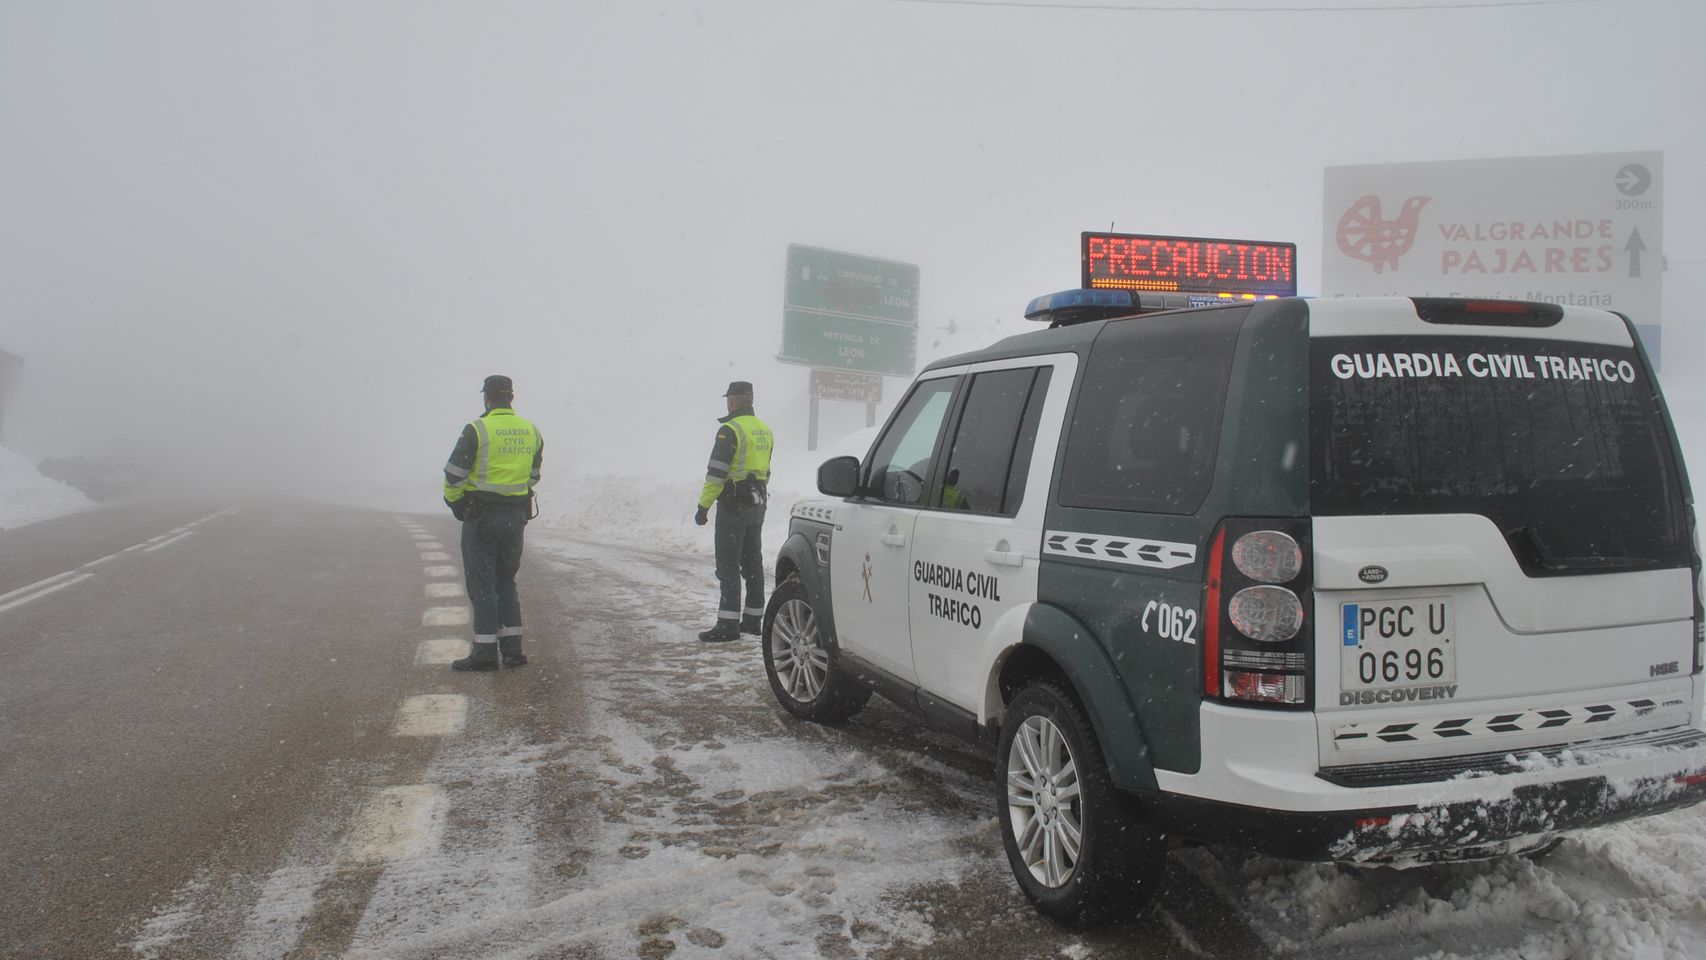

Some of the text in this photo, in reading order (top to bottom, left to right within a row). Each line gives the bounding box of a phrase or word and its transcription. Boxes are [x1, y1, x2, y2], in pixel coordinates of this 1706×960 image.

[1438, 219, 1613, 242] VALGRANDE
[1089, 237, 1291, 282] PRECAUCION
[1441, 244, 1613, 275] PAJARES
[1526, 290, 1613, 306] Montaña
[823, 330, 864, 344] PROVINCIA
[1331, 352, 1636, 384] GUARDIA CIVIL TRAFICO
[496, 428, 531, 437] GUARDIA
[503, 437, 525, 446] CIVIL
[913, 559, 1001, 602] GUARDIA CIVIL
[928, 593, 981, 630] TRAFICO
[1157, 603, 1197, 645] 062
[1360, 603, 1445, 640] PGC U
[1347, 629, 1355, 640] E
[1359, 647, 1444, 684] 0696
[1649, 660, 1679, 678] HSE
[1339, 684, 1458, 706] DISCOVERY
